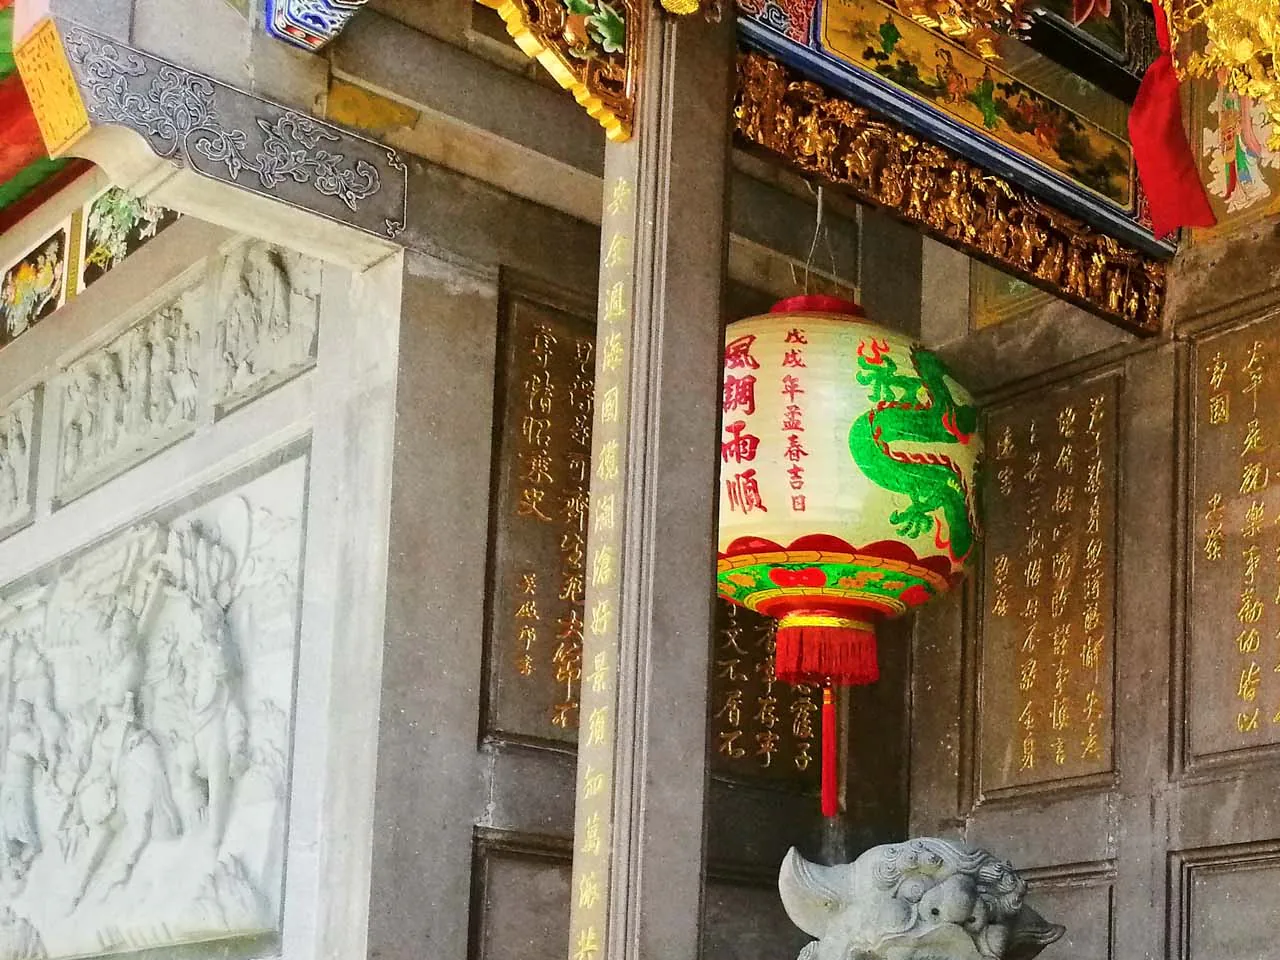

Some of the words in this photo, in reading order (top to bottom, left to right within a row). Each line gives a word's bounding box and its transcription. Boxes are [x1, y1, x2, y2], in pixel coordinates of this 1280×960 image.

[721, 334, 768, 515] 風調雨順
[781, 328, 809, 513] 戊戌年孟春吉日
